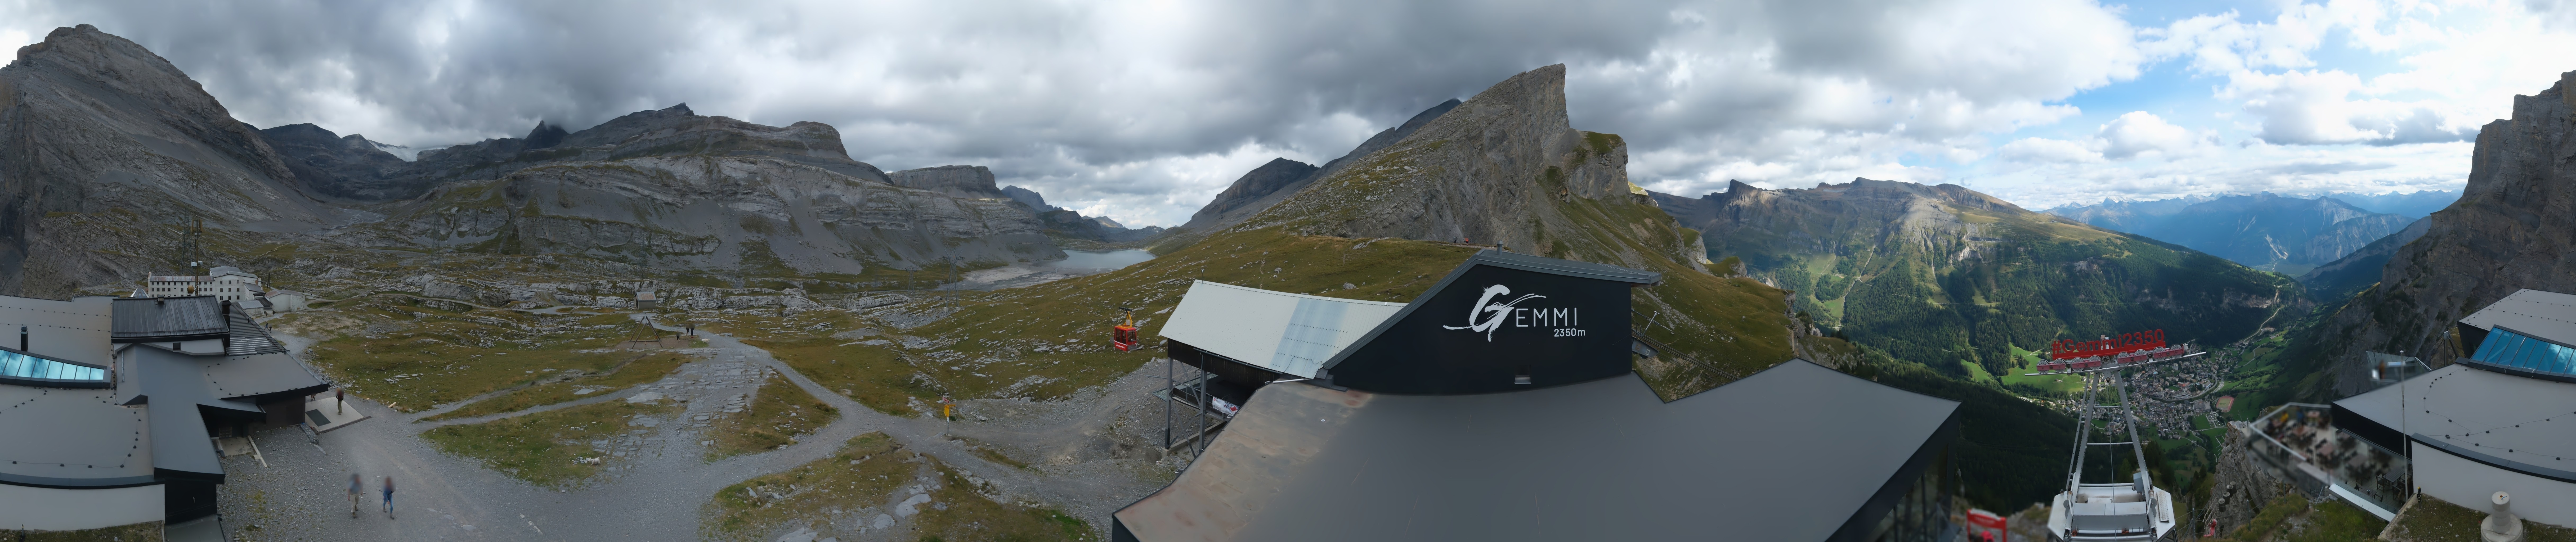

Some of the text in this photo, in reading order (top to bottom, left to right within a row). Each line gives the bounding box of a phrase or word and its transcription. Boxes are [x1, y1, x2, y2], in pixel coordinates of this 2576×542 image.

[1443, 284, 1577, 342] GEMMI
[1554, 328, 1585, 337] 2350m
[2051, 329, 2165, 354] #Gemmi2350
